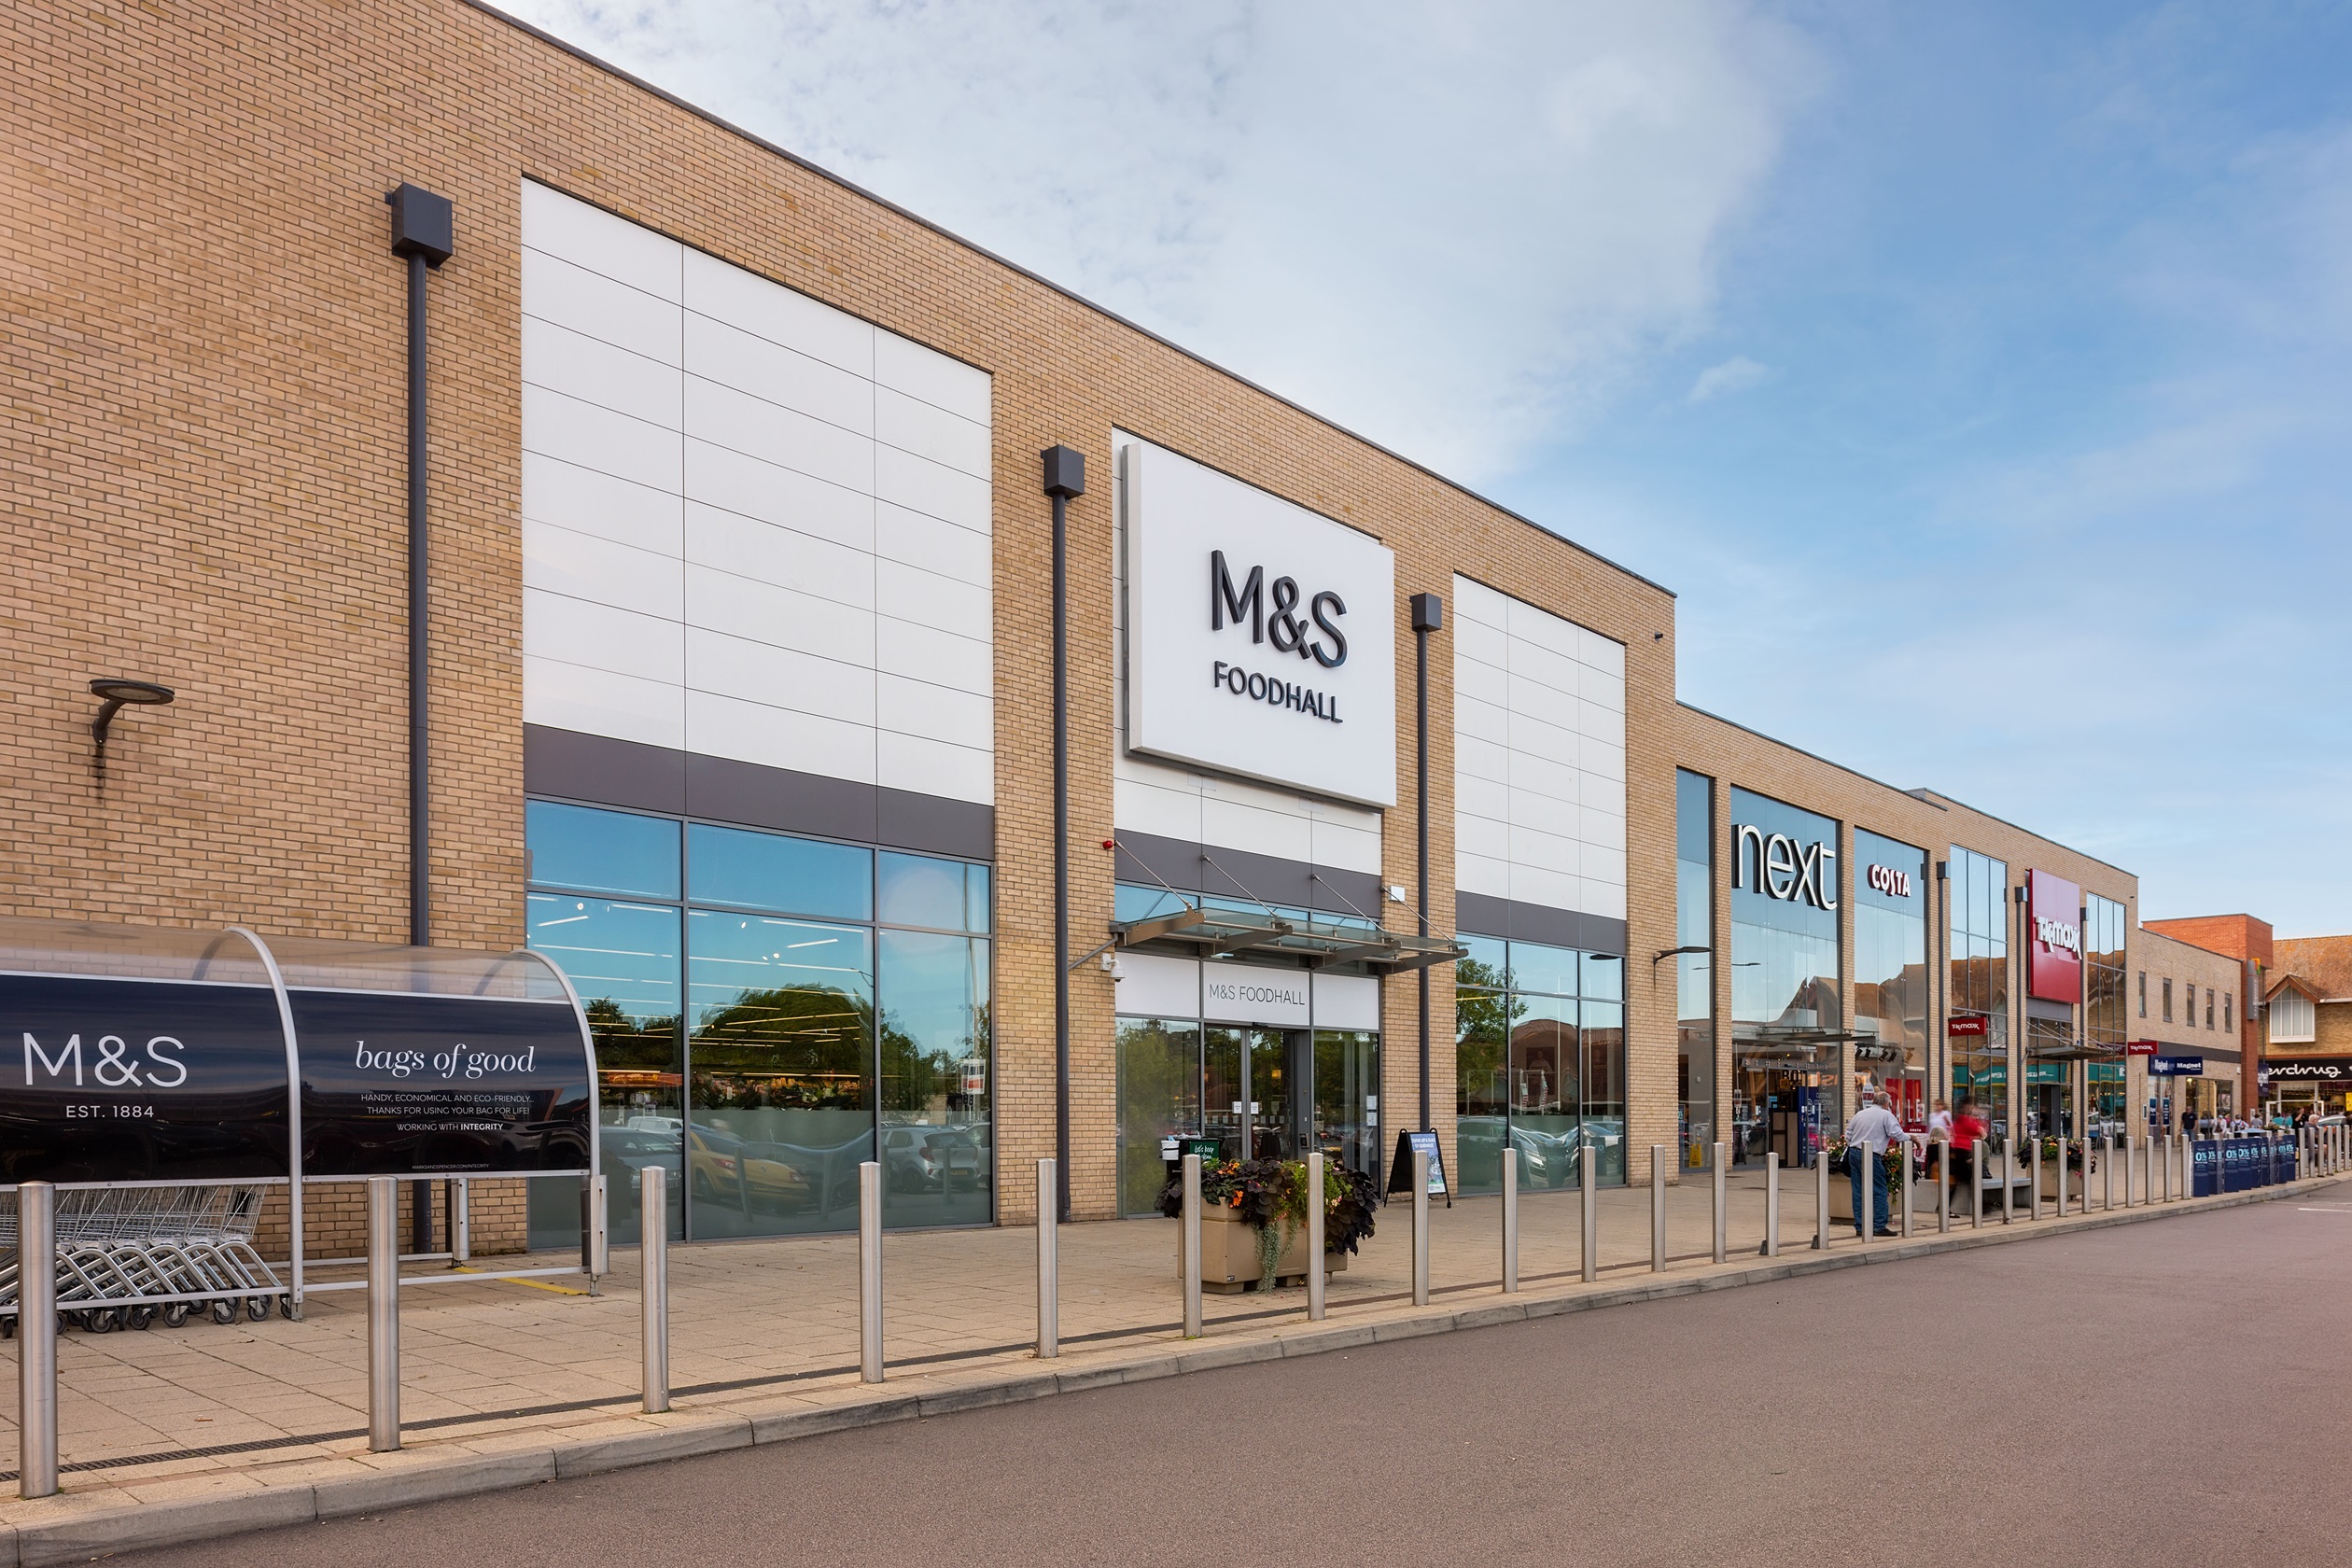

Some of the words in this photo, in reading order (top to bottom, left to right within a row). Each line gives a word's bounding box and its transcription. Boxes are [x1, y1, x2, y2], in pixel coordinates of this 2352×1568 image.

[1211, 550, 1348, 668] M&S
[1214, 661, 1344, 723] FOODHALL
[1731, 824, 1838, 910] next
[1868, 864, 1911, 897] COSTA
[1210, 984, 1236, 1000] M&S
[1239, 986, 1305, 1005] FOODHALL
[23, 1032, 187, 1087] M&S
[356, 1041, 425, 1078] bags
[433, 1043, 467, 1079] of
[466, 1046, 536, 1079] good
[2268, 1064, 2342, 1078] erdrug
[66, 1105, 105, 1118] EST.
[113, 1105, 154, 1117] 1884
[361, 1094, 394, 1103] HANDY,
[396, 1094, 452, 1102] ECONOMICAL
[2195, 1152, 2207, 1161] 0%
[2226, 1149, 2238, 1159] 0%
